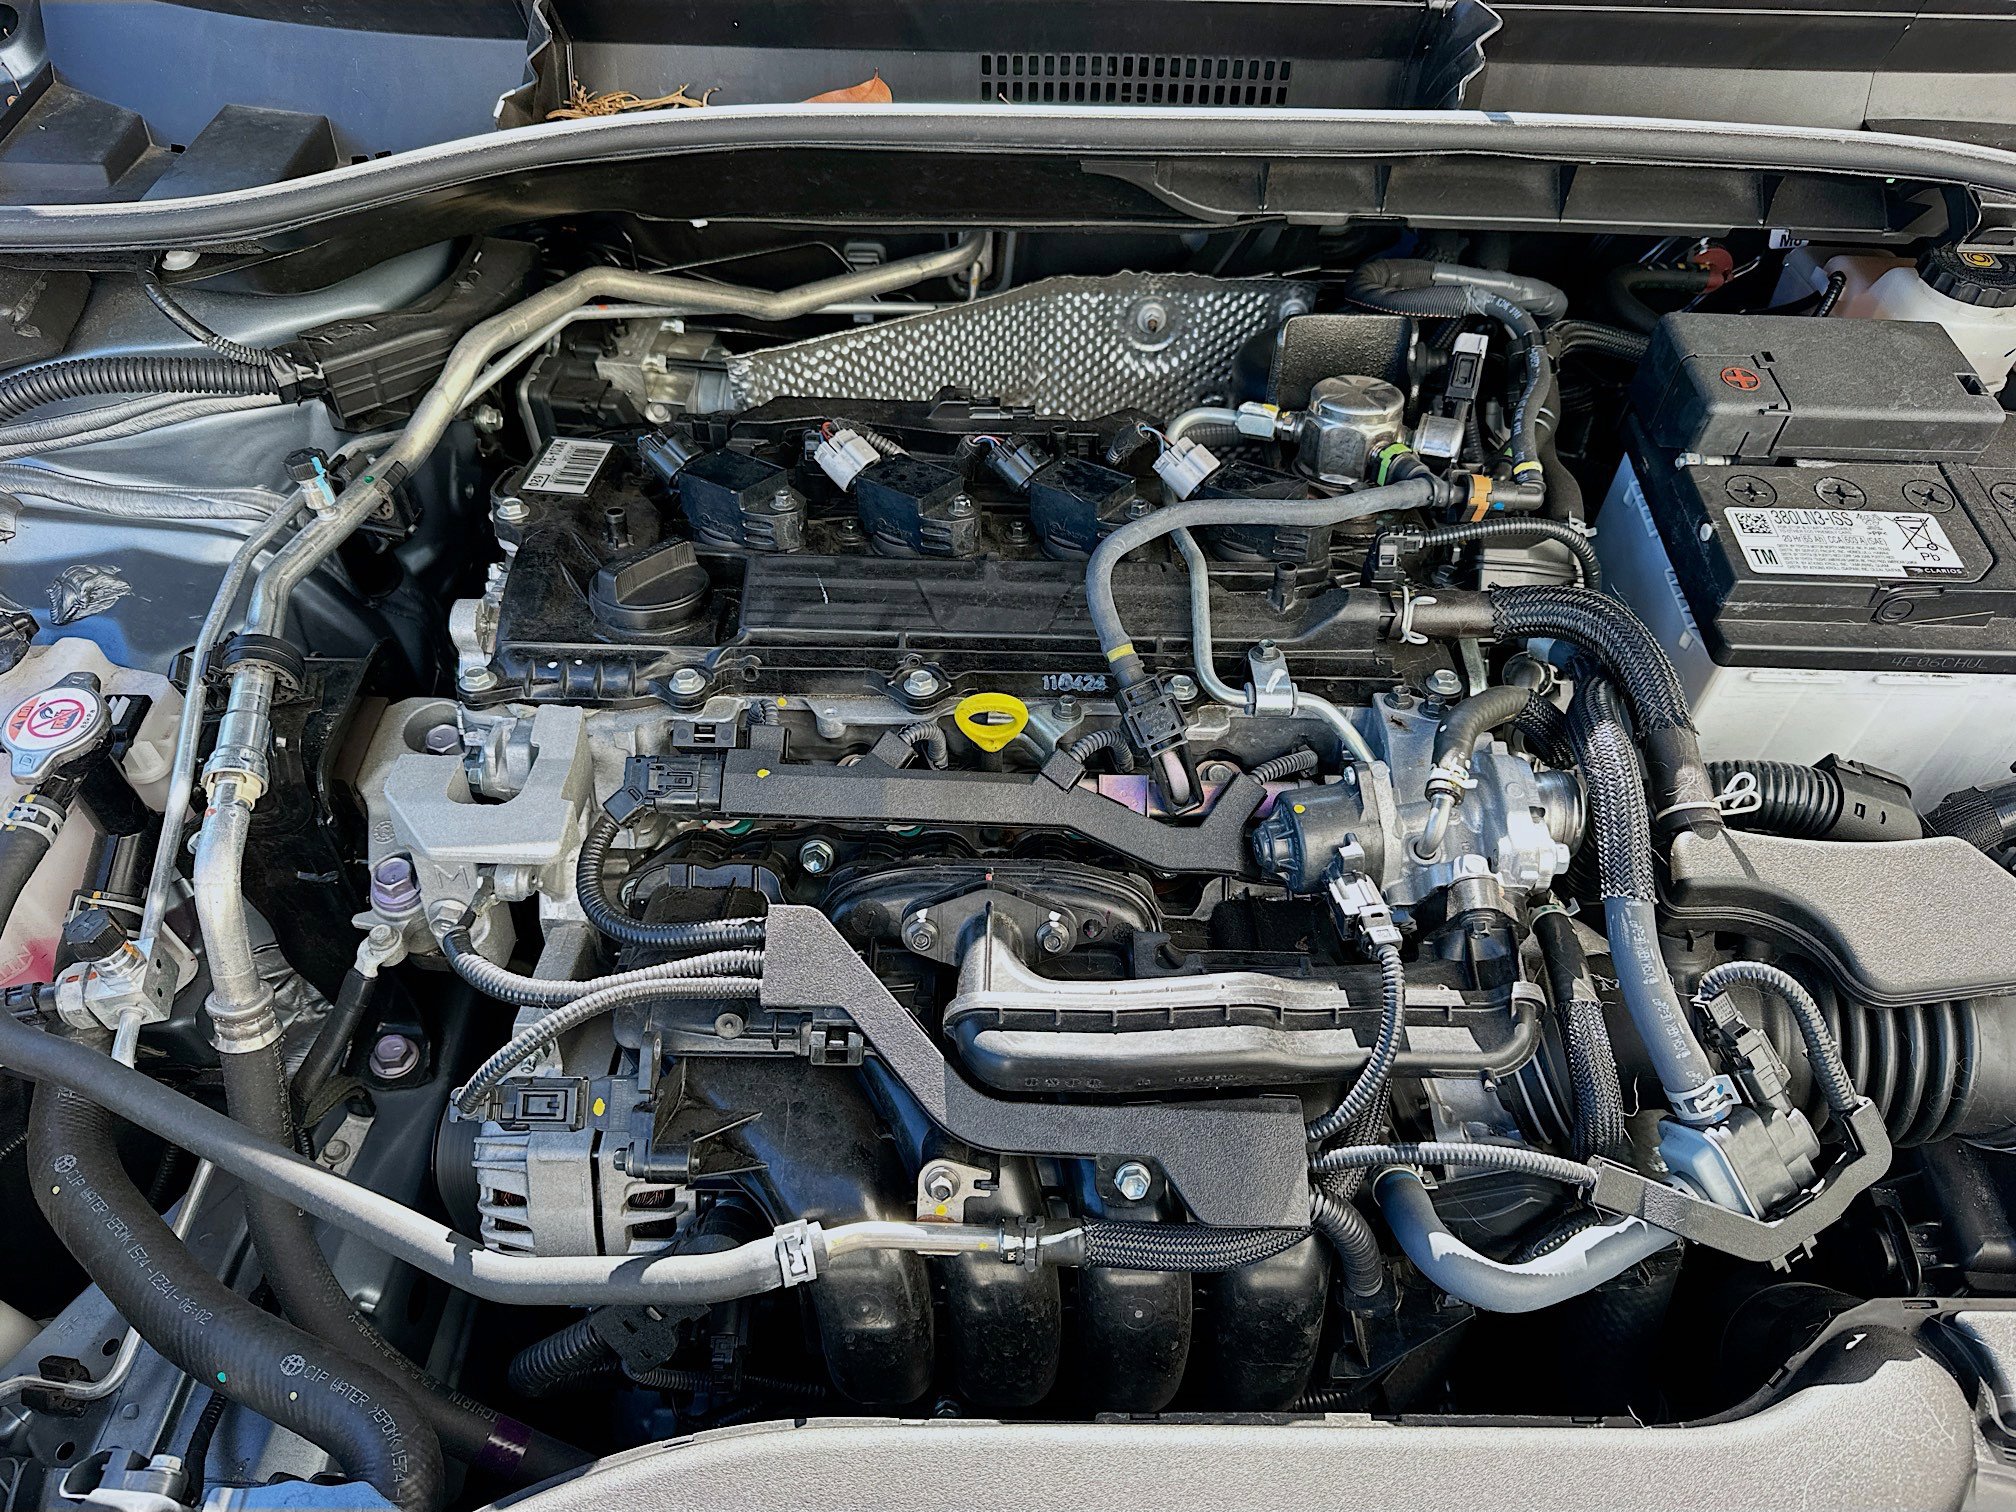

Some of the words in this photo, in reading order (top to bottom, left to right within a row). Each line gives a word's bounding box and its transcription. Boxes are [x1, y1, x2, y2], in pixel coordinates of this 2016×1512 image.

[1770, 510, 1853, 526] 380LN3-ISS
[1750, 549, 1779, 565] TM
[1920, 552, 1941, 562] Pb
[1924, 567, 1963, 575] CLARIOS
[79, 1186, 110, 1216] WATER
[329, 1377, 371, 1408] WATER
[449, 1390, 501, 1423] ICHIRIN
